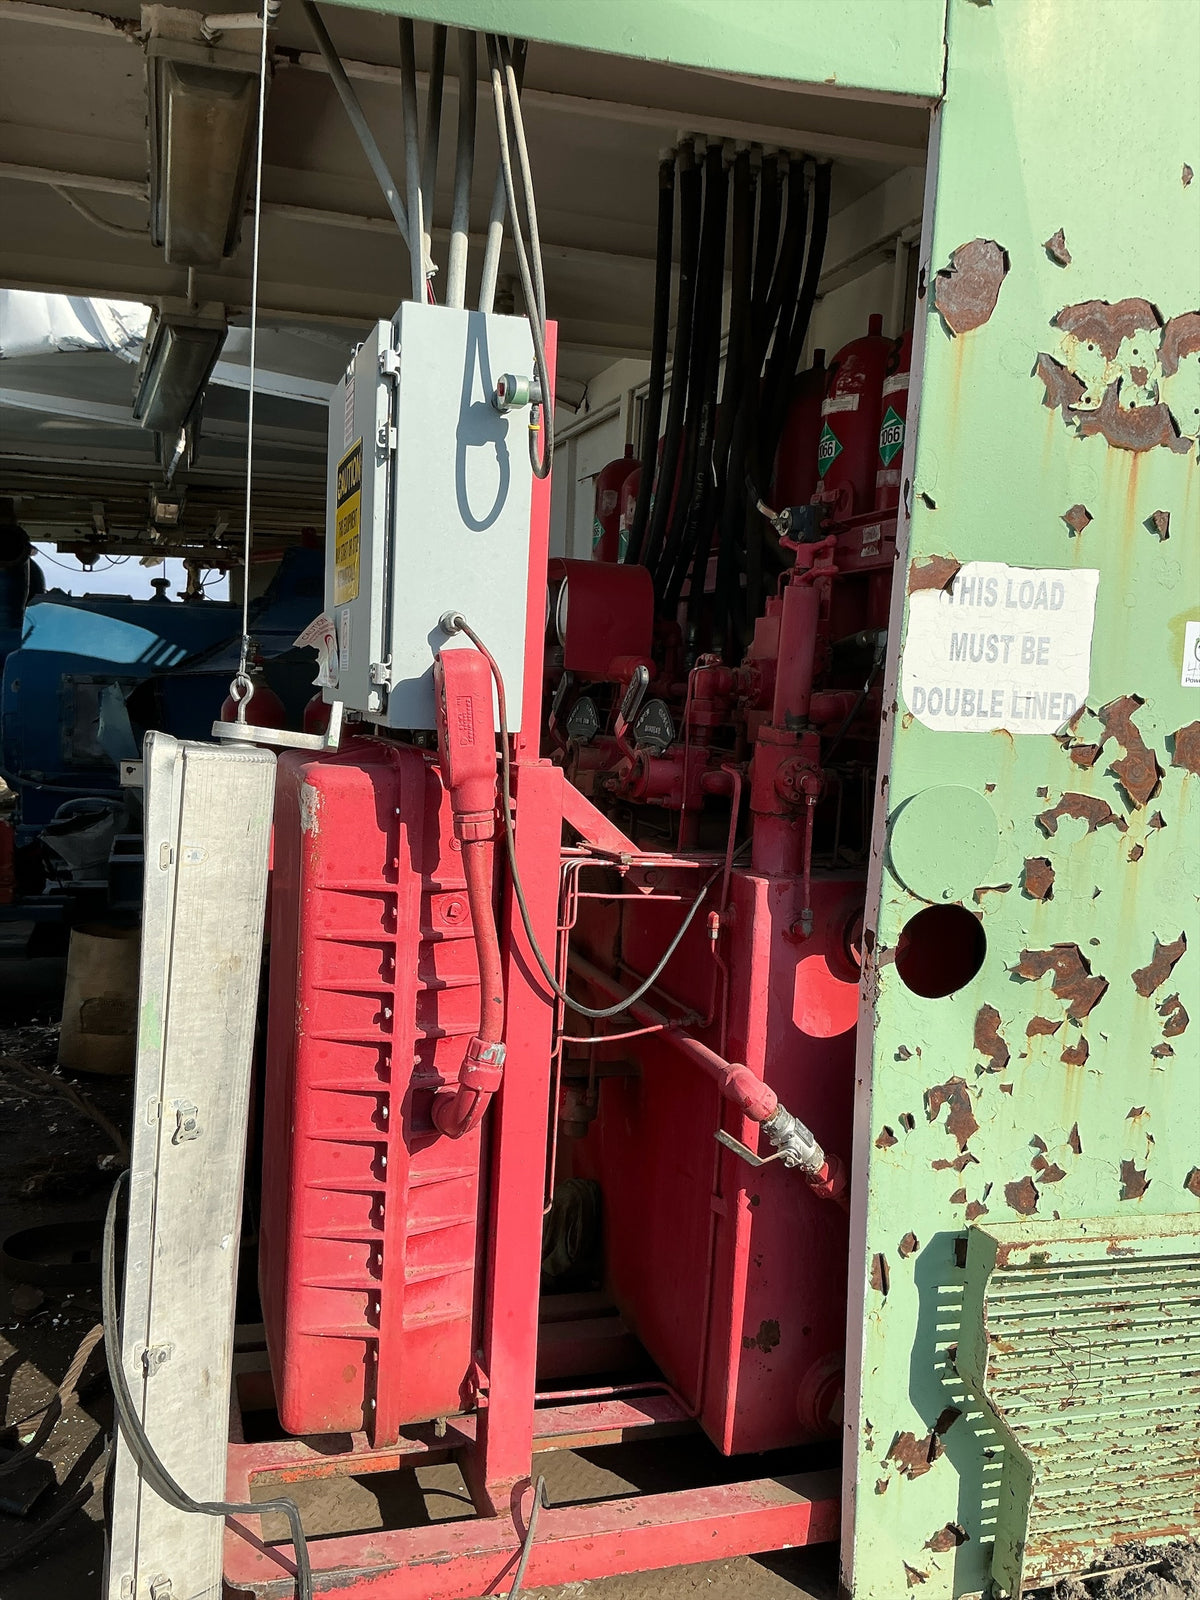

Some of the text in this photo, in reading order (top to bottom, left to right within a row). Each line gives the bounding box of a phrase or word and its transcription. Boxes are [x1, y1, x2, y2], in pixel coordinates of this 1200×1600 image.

[819, 441, 834, 460] 066
[880, 426, 901, 446] 1066
[337, 455, 361, 500] CAUTION
[950, 575, 1065, 611] THIS LOAD
[950, 632, 1051, 666] MUST BE
[911, 686, 1077, 721] DOUBLE LINED
